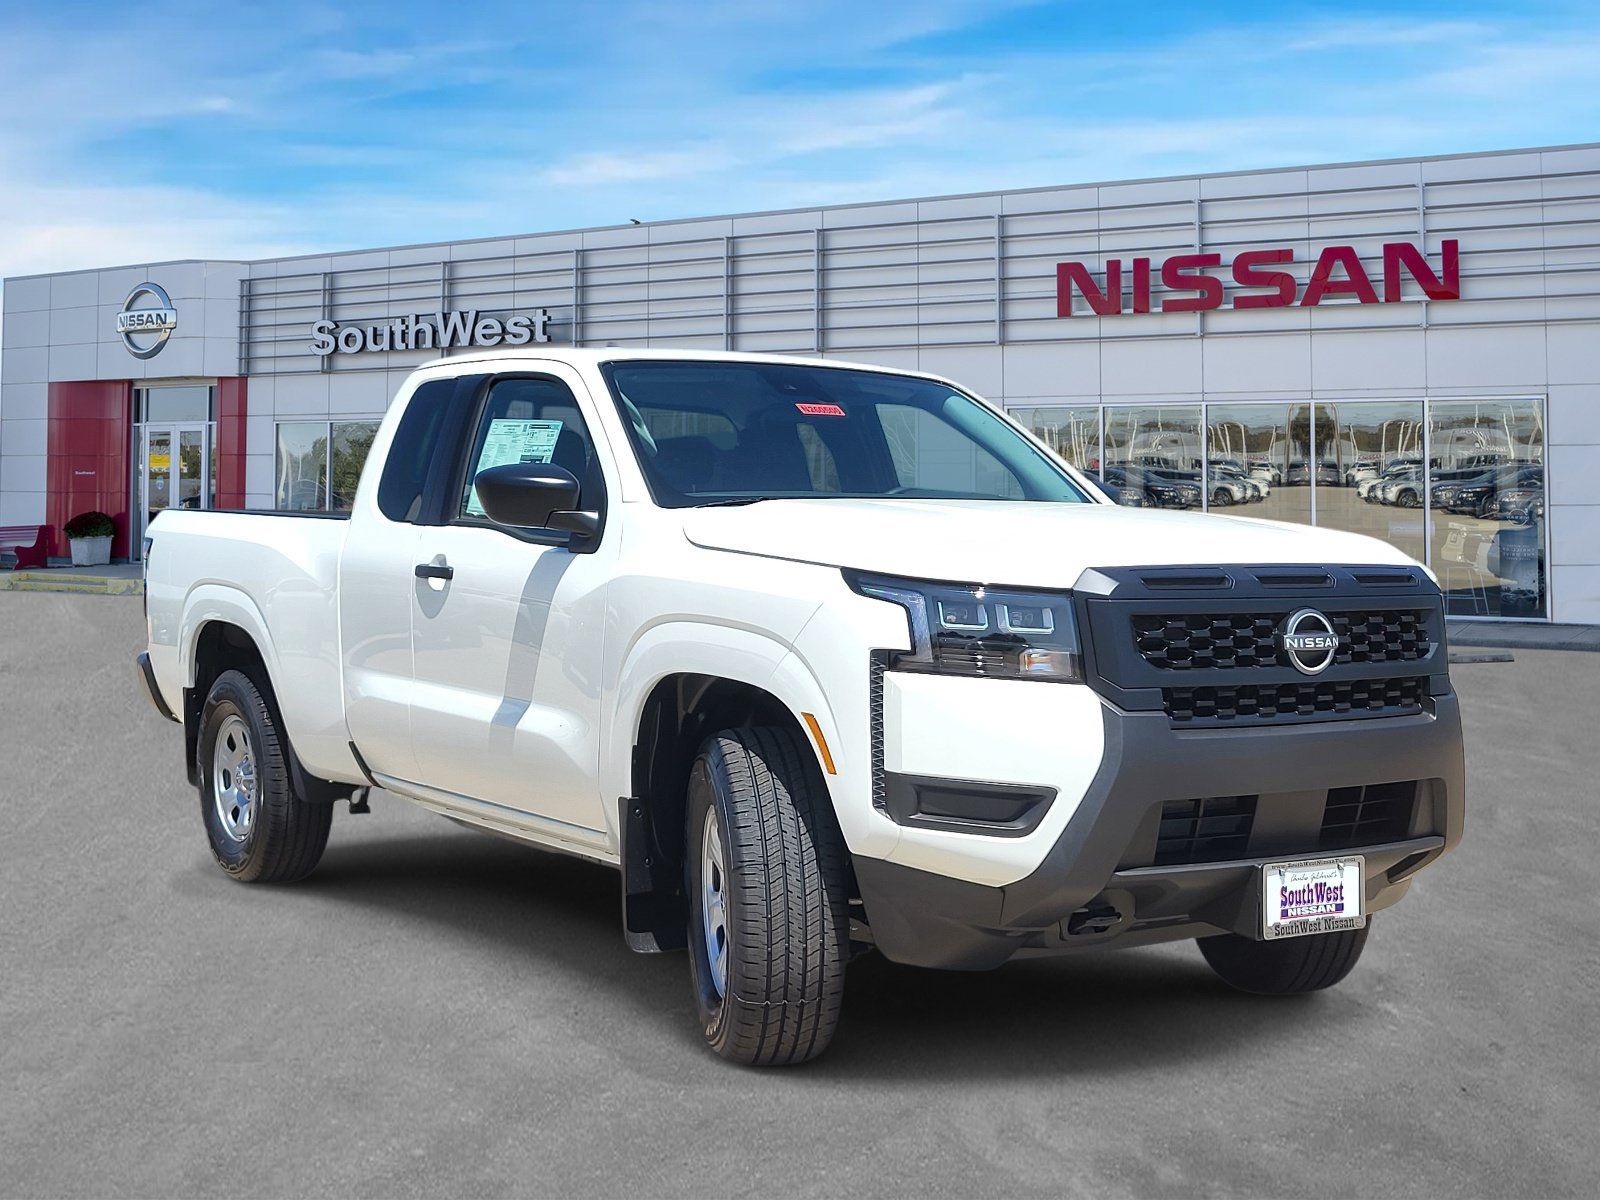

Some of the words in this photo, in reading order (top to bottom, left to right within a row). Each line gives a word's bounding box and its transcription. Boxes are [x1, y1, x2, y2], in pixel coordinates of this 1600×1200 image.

[1056, 239, 1460, 318] NISSAN
[118, 312, 168, 328] NISSAN
[309, 308, 551, 356] SouthWest
[1286, 637, 1338, 648] NISSAN
[1280, 881, 1344, 908] SouthWest
[1287, 903, 1336, 917] NISSAN
[1274, 919, 1322, 936] SouthWest
[1323, 918, 1355, 931] Nissan
